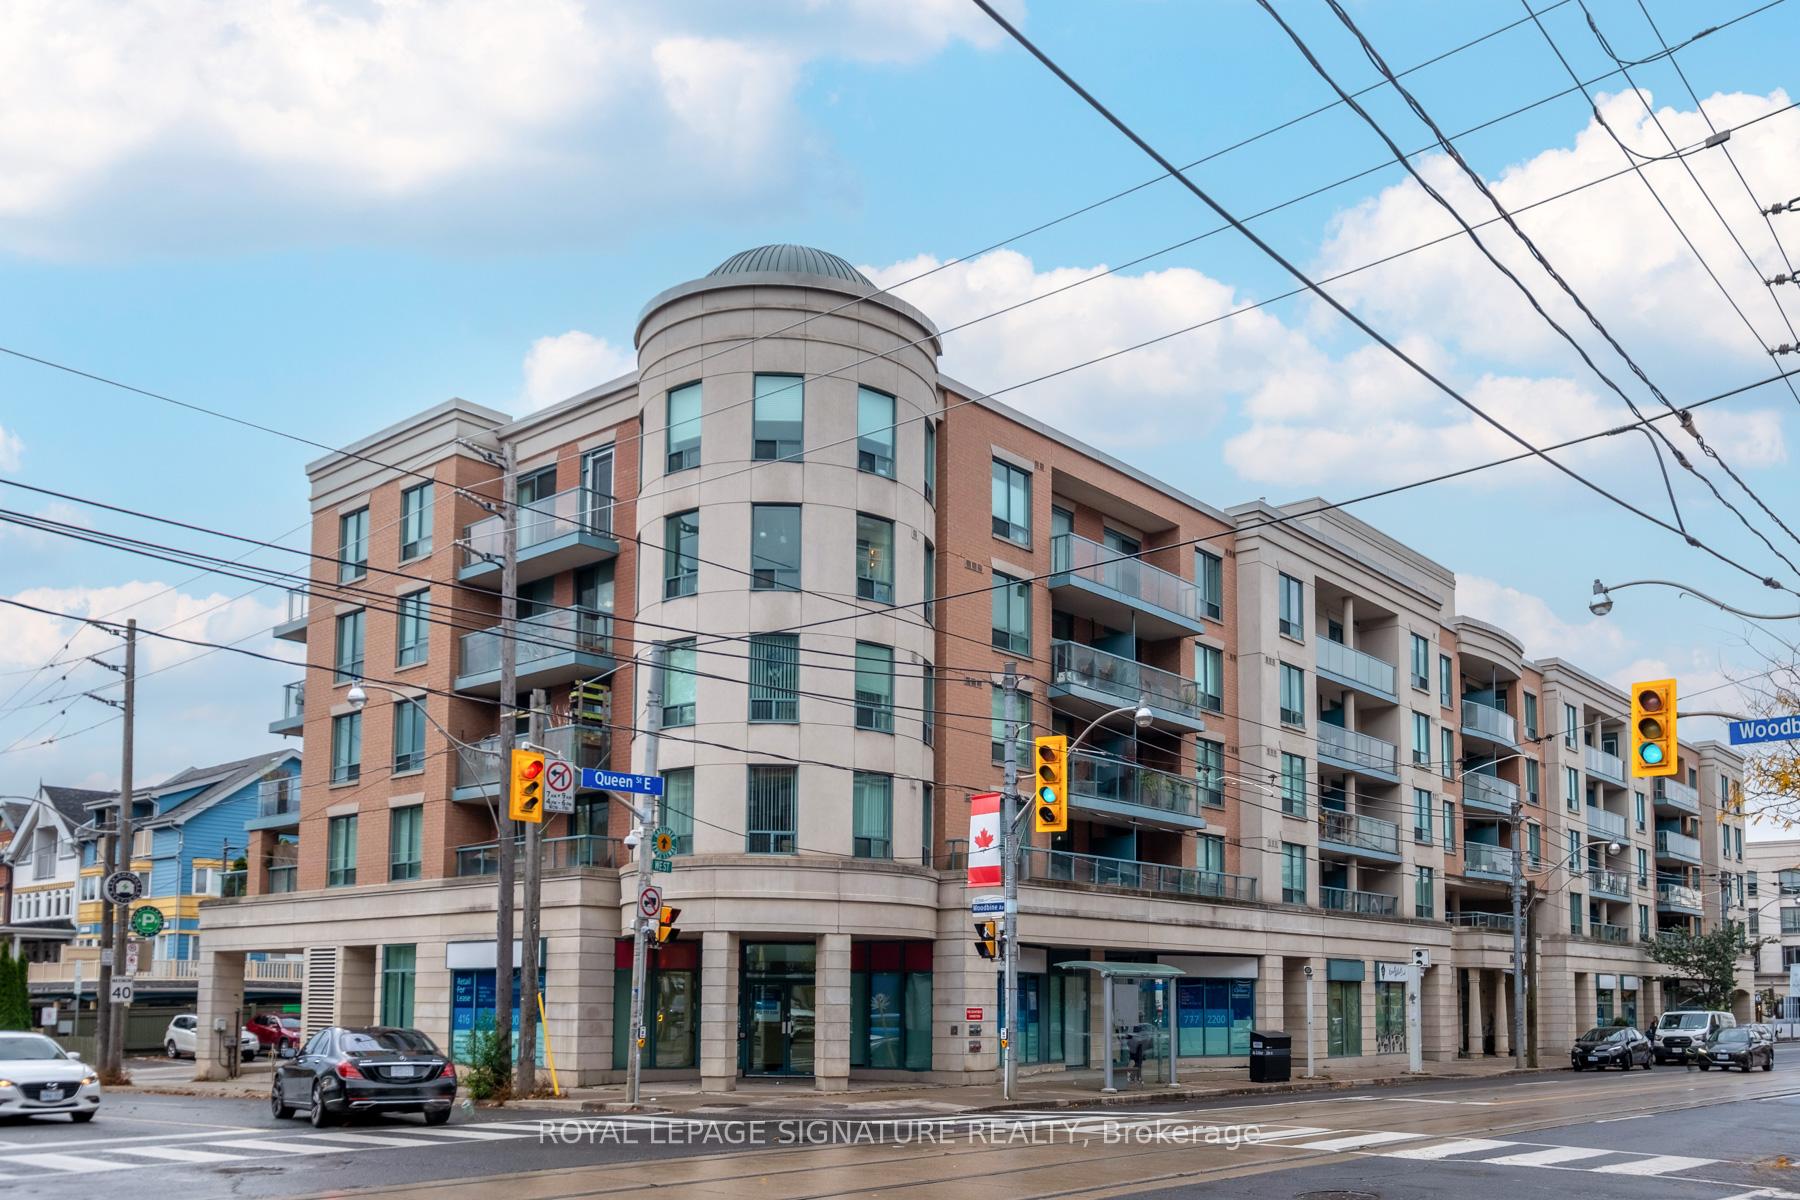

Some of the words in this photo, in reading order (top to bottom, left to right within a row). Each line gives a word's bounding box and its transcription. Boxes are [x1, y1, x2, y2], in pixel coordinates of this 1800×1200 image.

[1739, 717, 1800, 739] Woodb
[594, 771, 633, 788] Queen
[635, 776, 642, 784] St
[644, 777, 651, 790] E
[654, 862, 670, 872] WEST
[141, 913, 155, 926] P
[456, 977, 472, 986] Retail
[112, 986, 131, 999] 40
[456, 985, 465, 994] For
[458, 1015, 470, 1025] 416
[1183, 1015, 1199, 1024] 777
[1207, 1015, 1226, 1024] 2200
